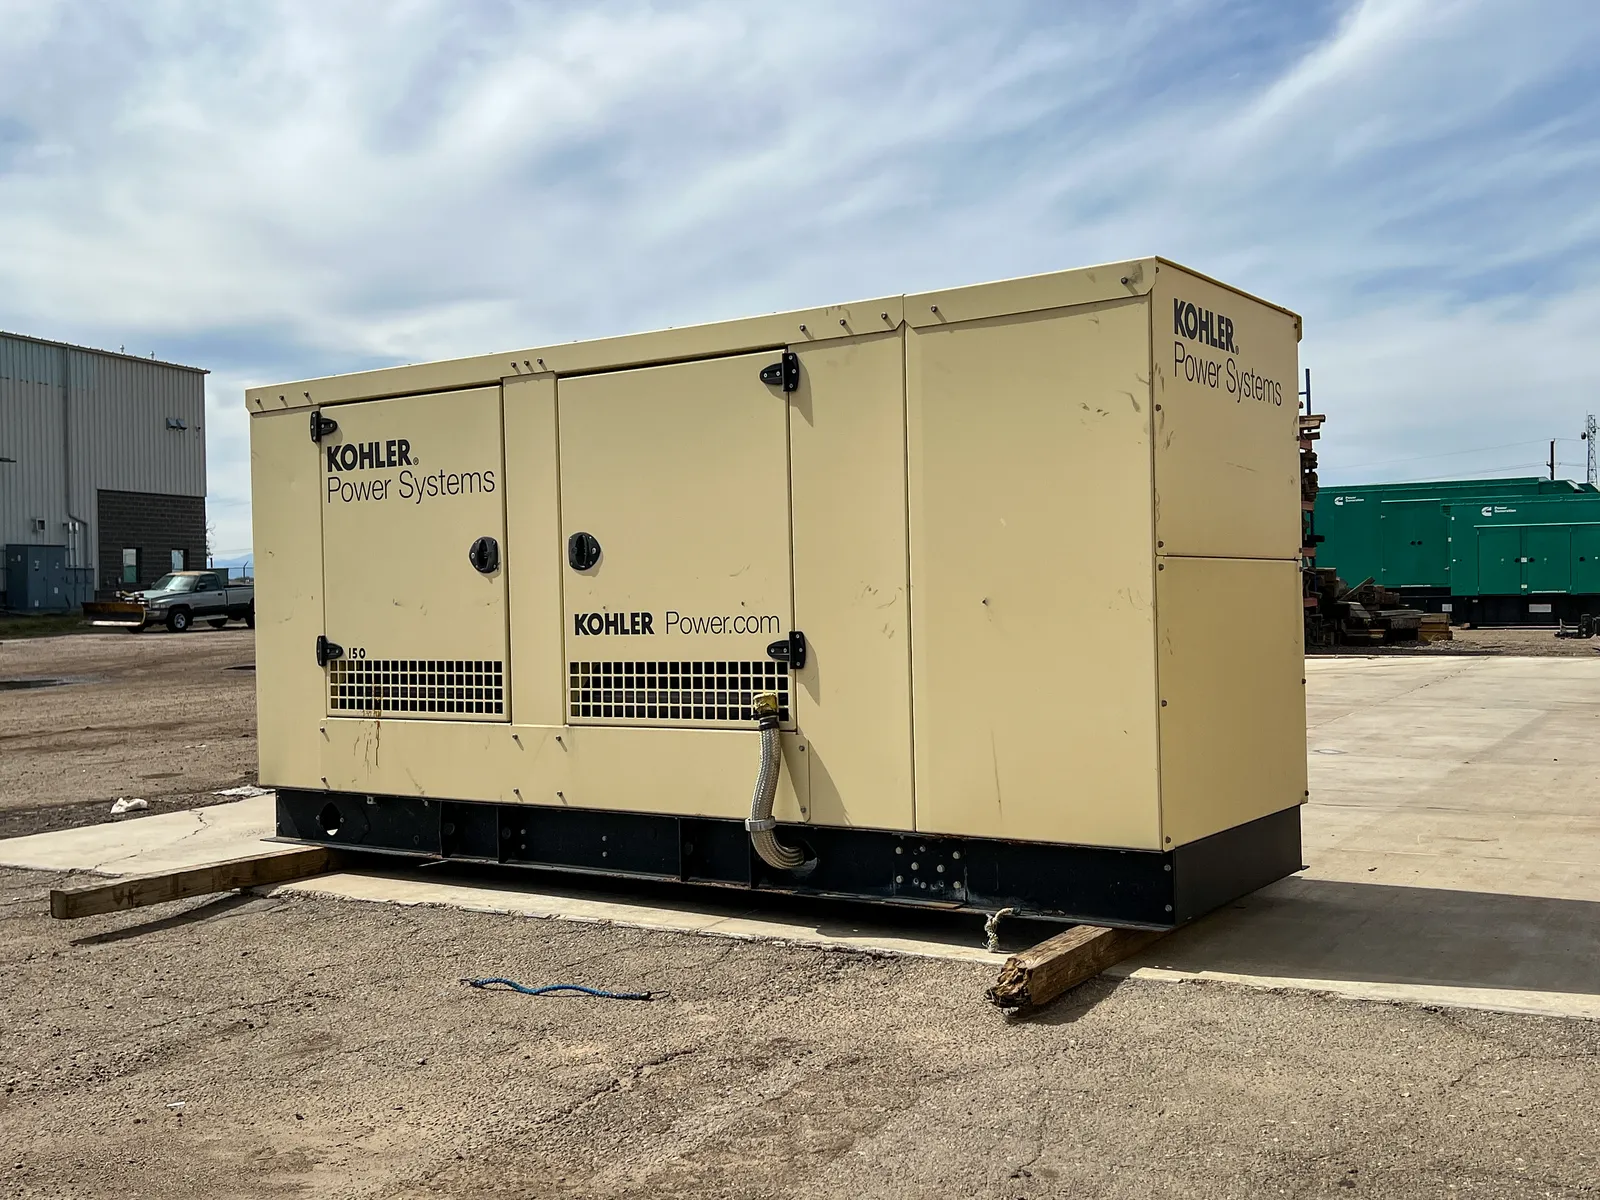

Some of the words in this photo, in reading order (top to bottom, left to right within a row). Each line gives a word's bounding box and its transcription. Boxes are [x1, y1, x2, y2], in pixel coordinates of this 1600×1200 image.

[1174, 341, 1222, 389] Power
[1226, 357, 1282, 407] Systems
[327, 476, 392, 504] Power
[398, 469, 496, 505] Systems
[574, 612, 655, 636] KOHLER
[665, 611, 780, 635] Power.com
[348, 647, 366, 660] 150
